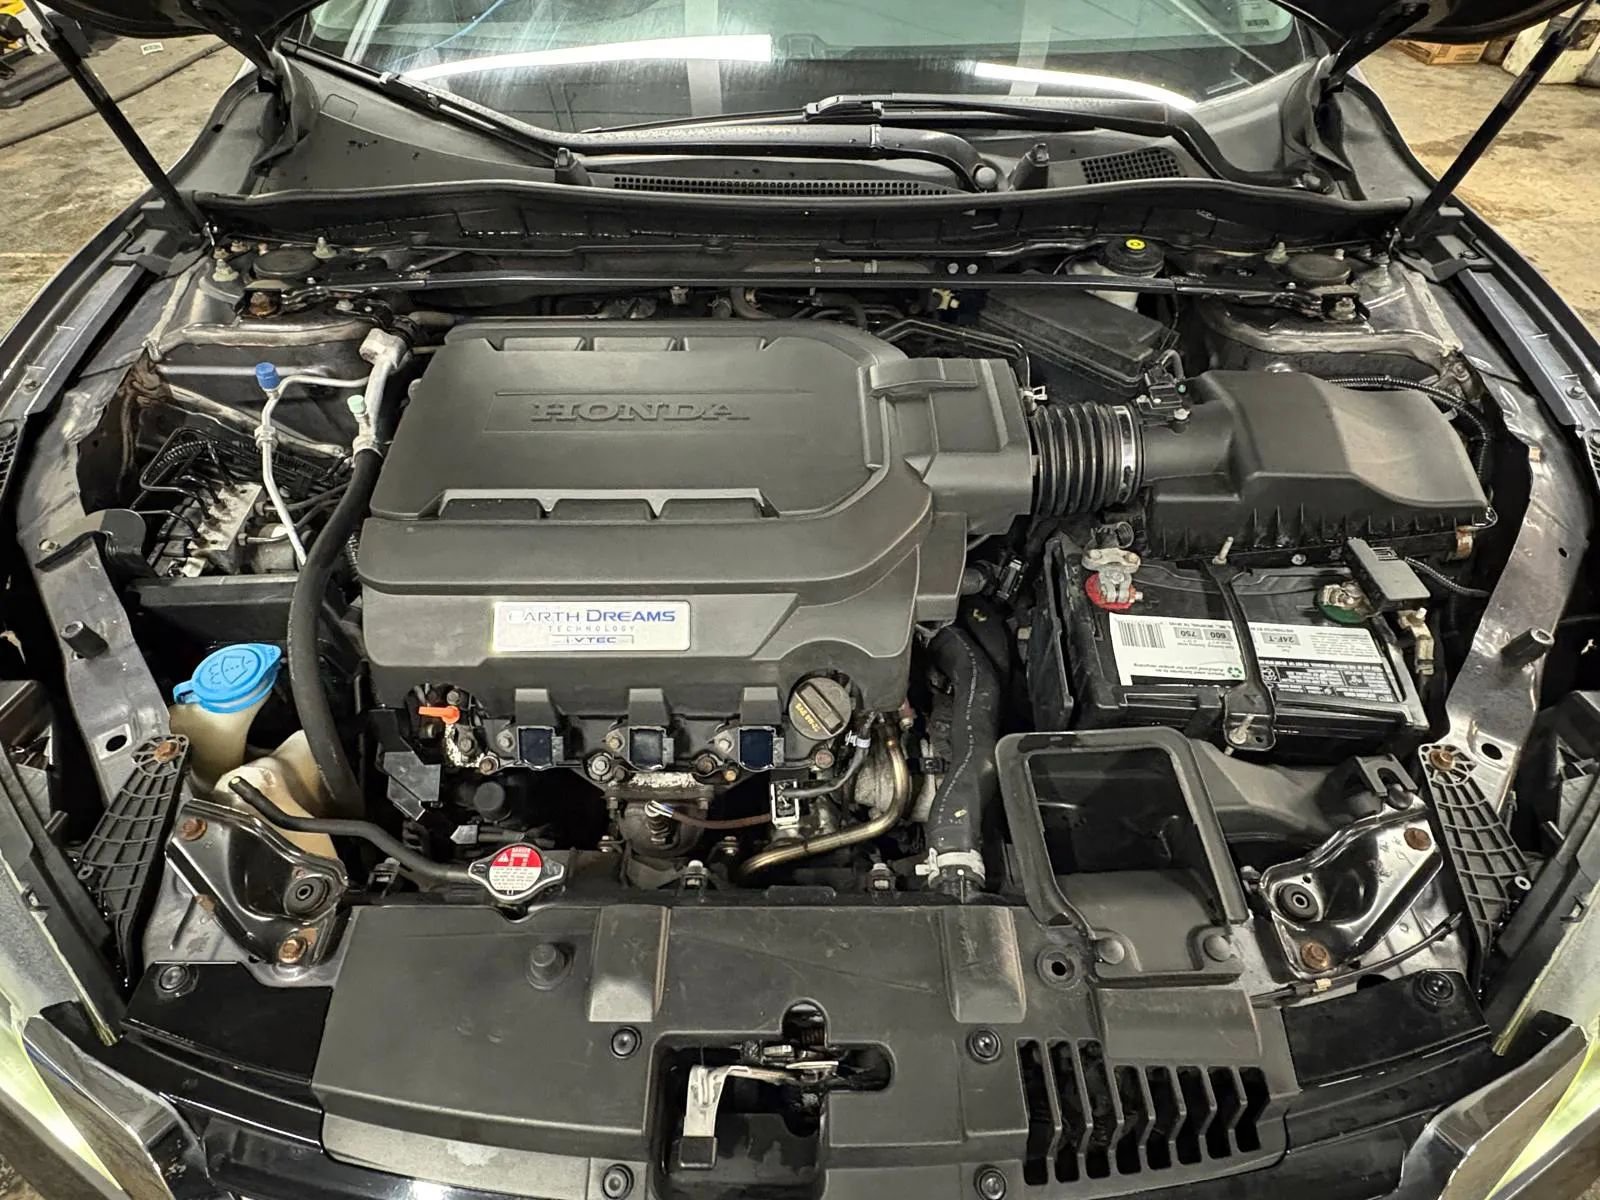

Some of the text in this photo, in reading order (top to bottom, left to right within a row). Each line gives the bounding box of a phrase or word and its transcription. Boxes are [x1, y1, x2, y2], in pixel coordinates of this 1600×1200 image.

[531, 402, 751, 422] HONDA
[586, 609, 676, 623] DREAMS
[1180, 630, 1227, 639] 600 750
[1268, 635, 1295, 643] 24F-T
